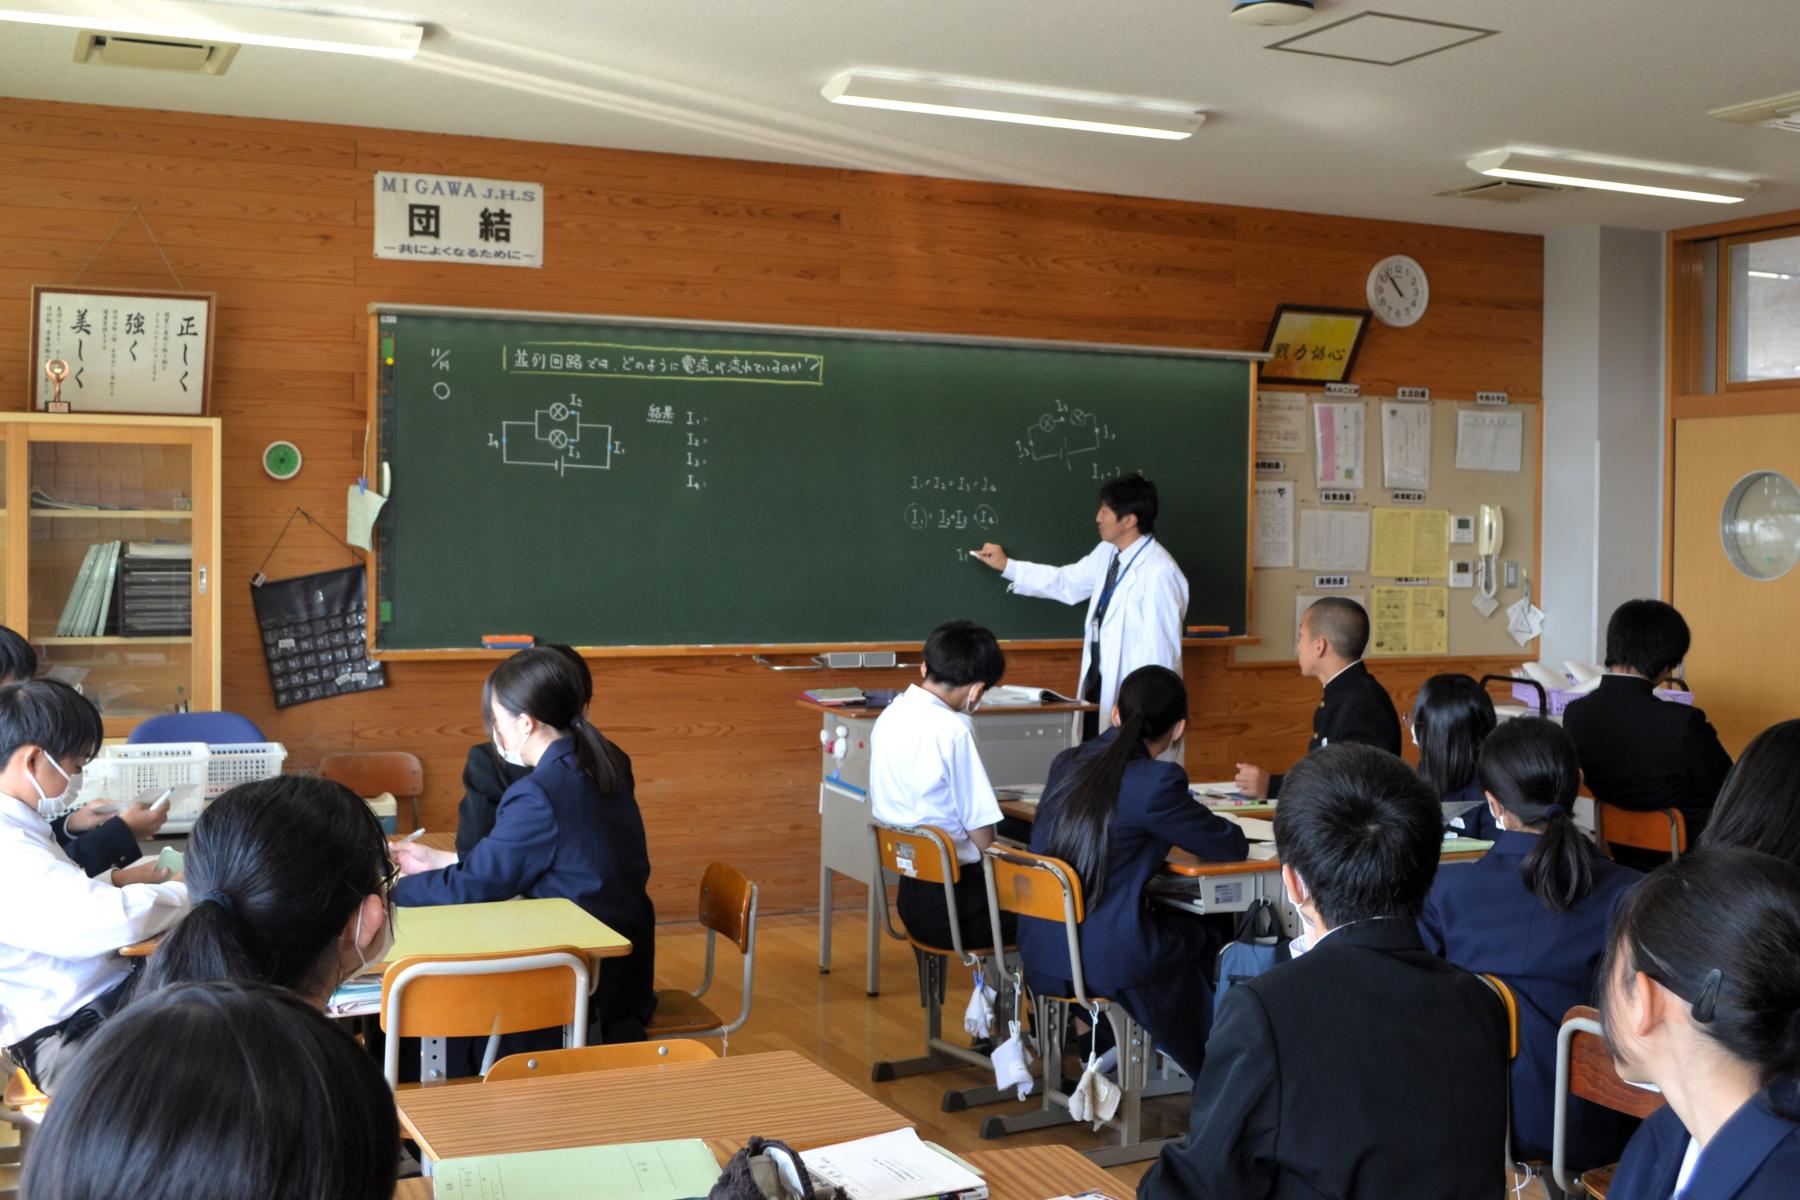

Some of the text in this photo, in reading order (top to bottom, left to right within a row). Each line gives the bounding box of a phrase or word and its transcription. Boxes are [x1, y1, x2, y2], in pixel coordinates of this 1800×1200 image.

[381, 176, 535, 202] MIGAWA J.H.S
[70, 308, 92, 388] 美しく
[125, 312, 146, 362] 強く
[176, 316, 199, 392] 正しく
[648, 404, 675, 419] 結果
